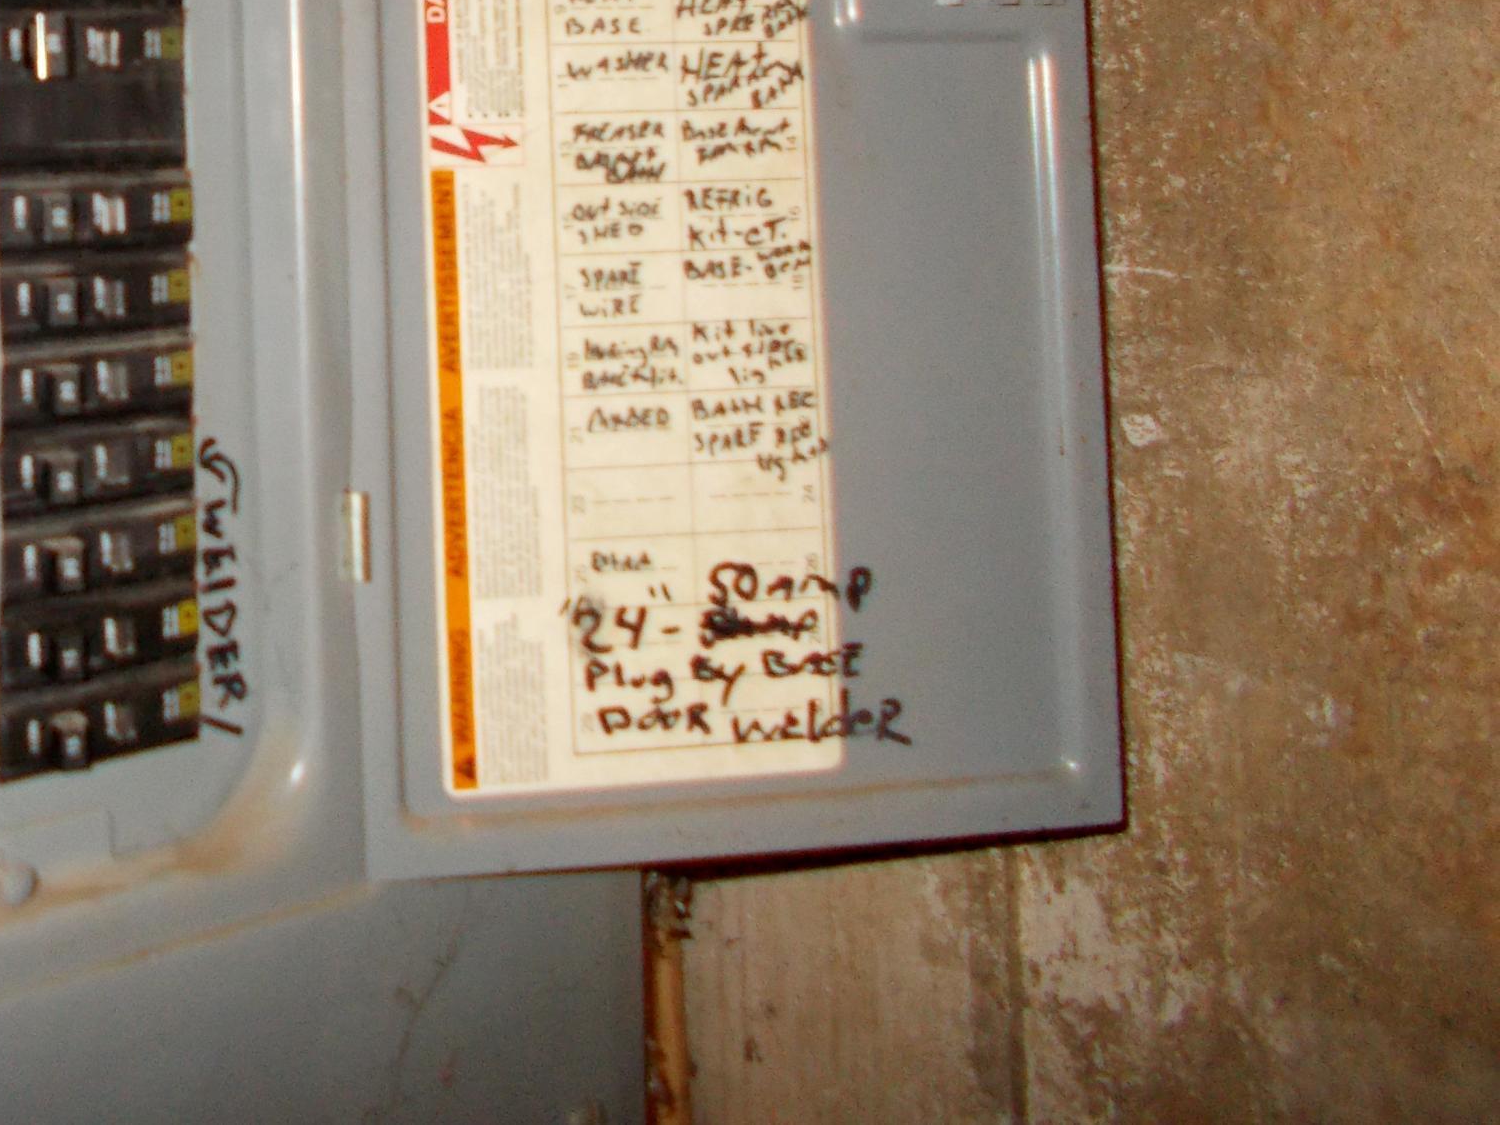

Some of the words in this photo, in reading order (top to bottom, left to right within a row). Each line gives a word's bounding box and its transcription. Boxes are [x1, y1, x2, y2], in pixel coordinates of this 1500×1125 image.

[565, 17, 642, 37] BASE
[584, 658, 676, 704] Plug
[690, 655, 746, 706] By
